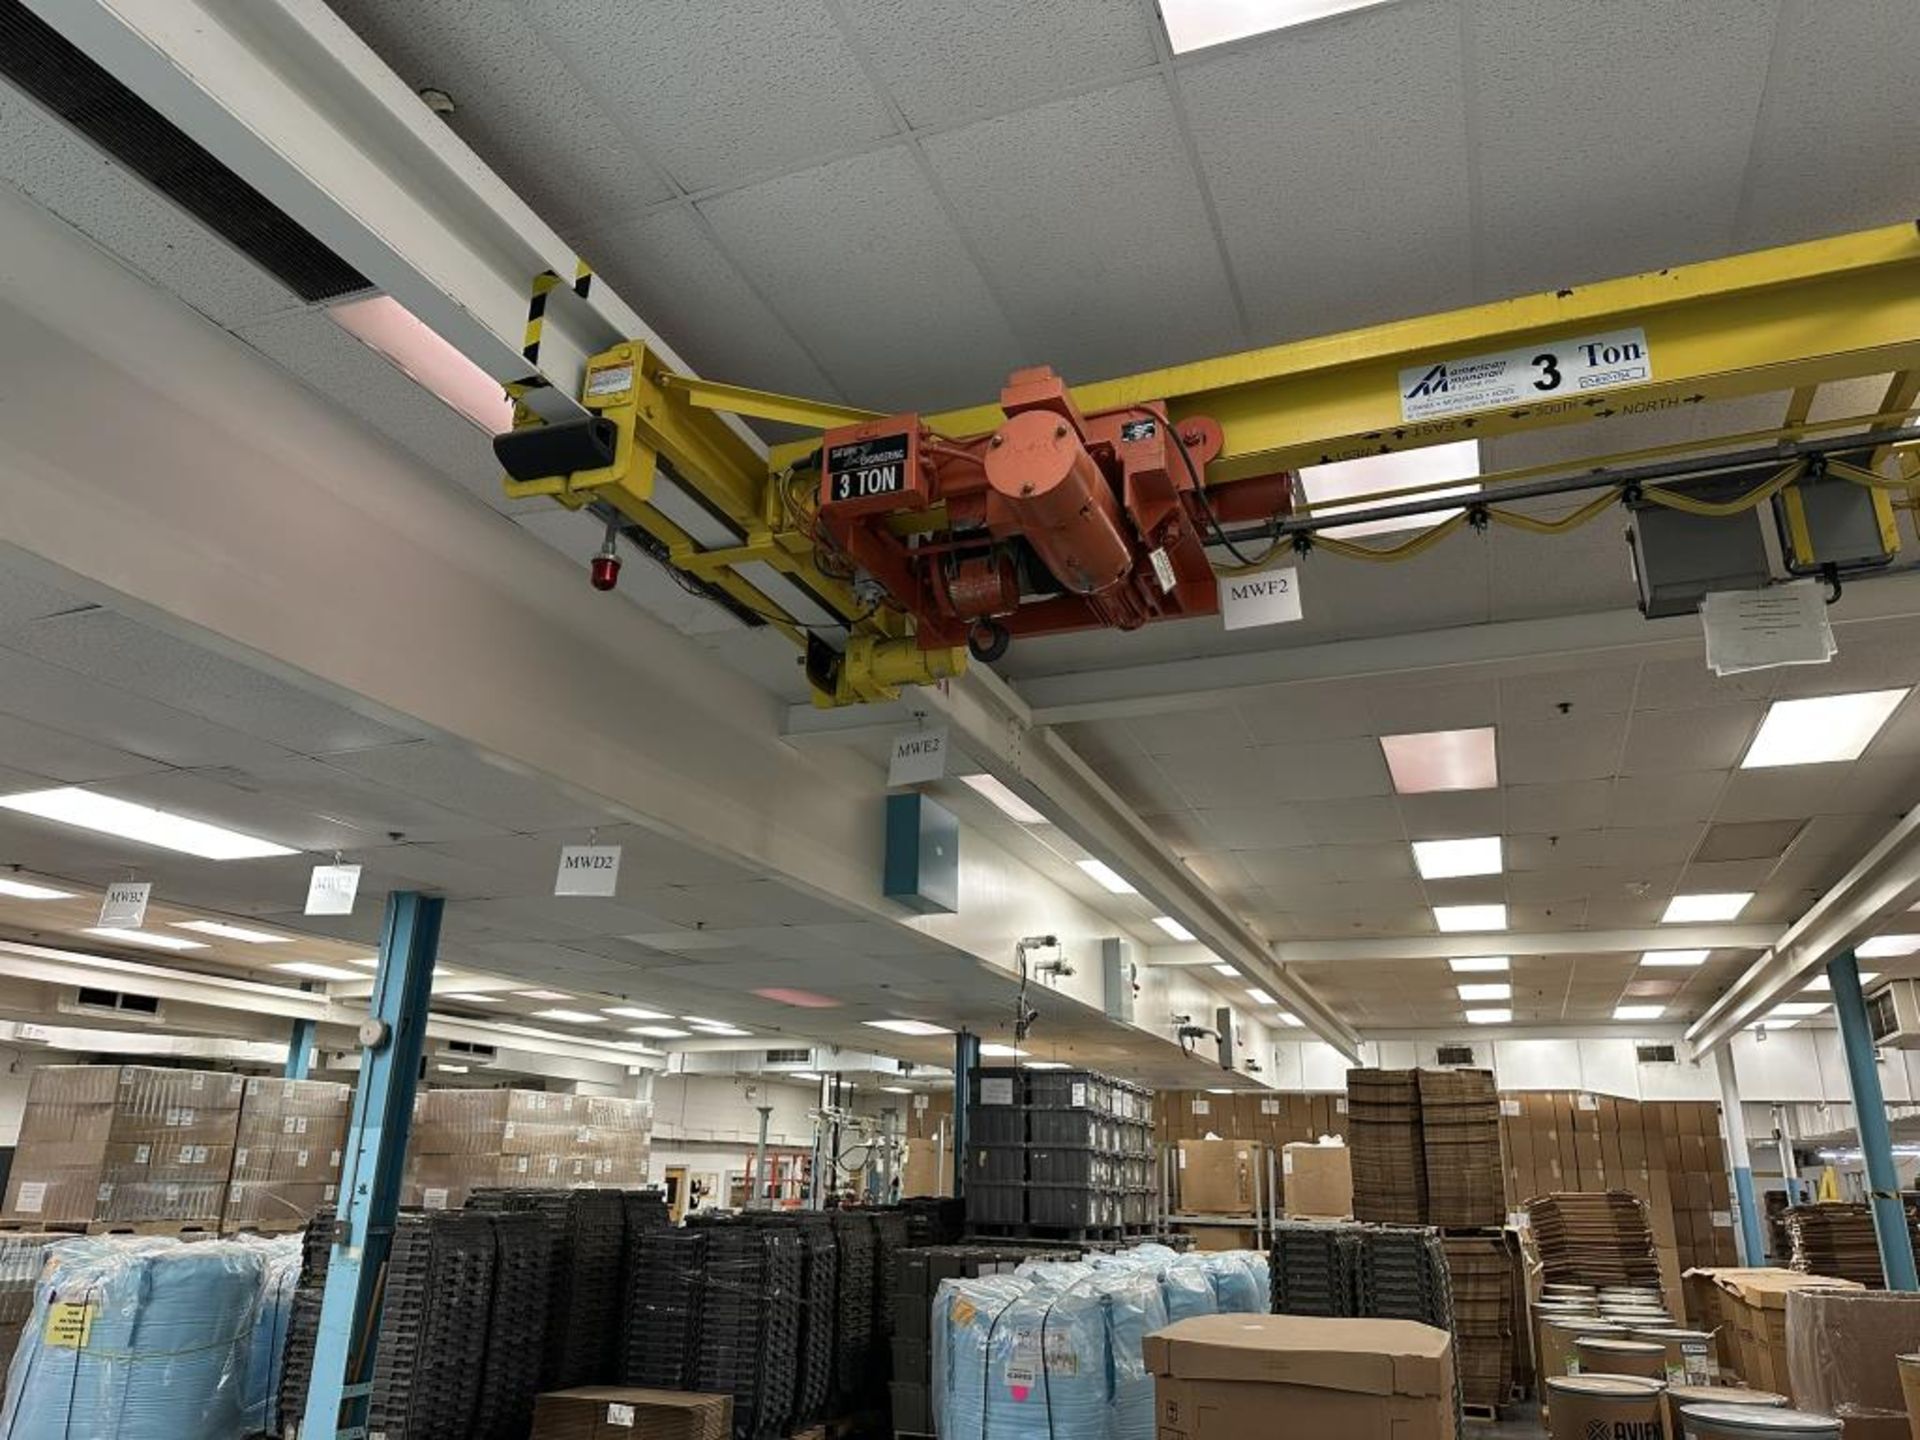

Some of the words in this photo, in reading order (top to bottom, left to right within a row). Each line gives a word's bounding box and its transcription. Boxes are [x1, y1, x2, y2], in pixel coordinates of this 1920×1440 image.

[1578, 342, 1641, 368] Ton
[1531, 353, 1562, 391] 3
[1622, 397, 1680, 415] NORTH
[840, 473, 850, 498] 3
[857, 466, 896, 496] TON
[1231, 579, 1289, 601] MWF2
[564, 855, 613, 869] MWD2
